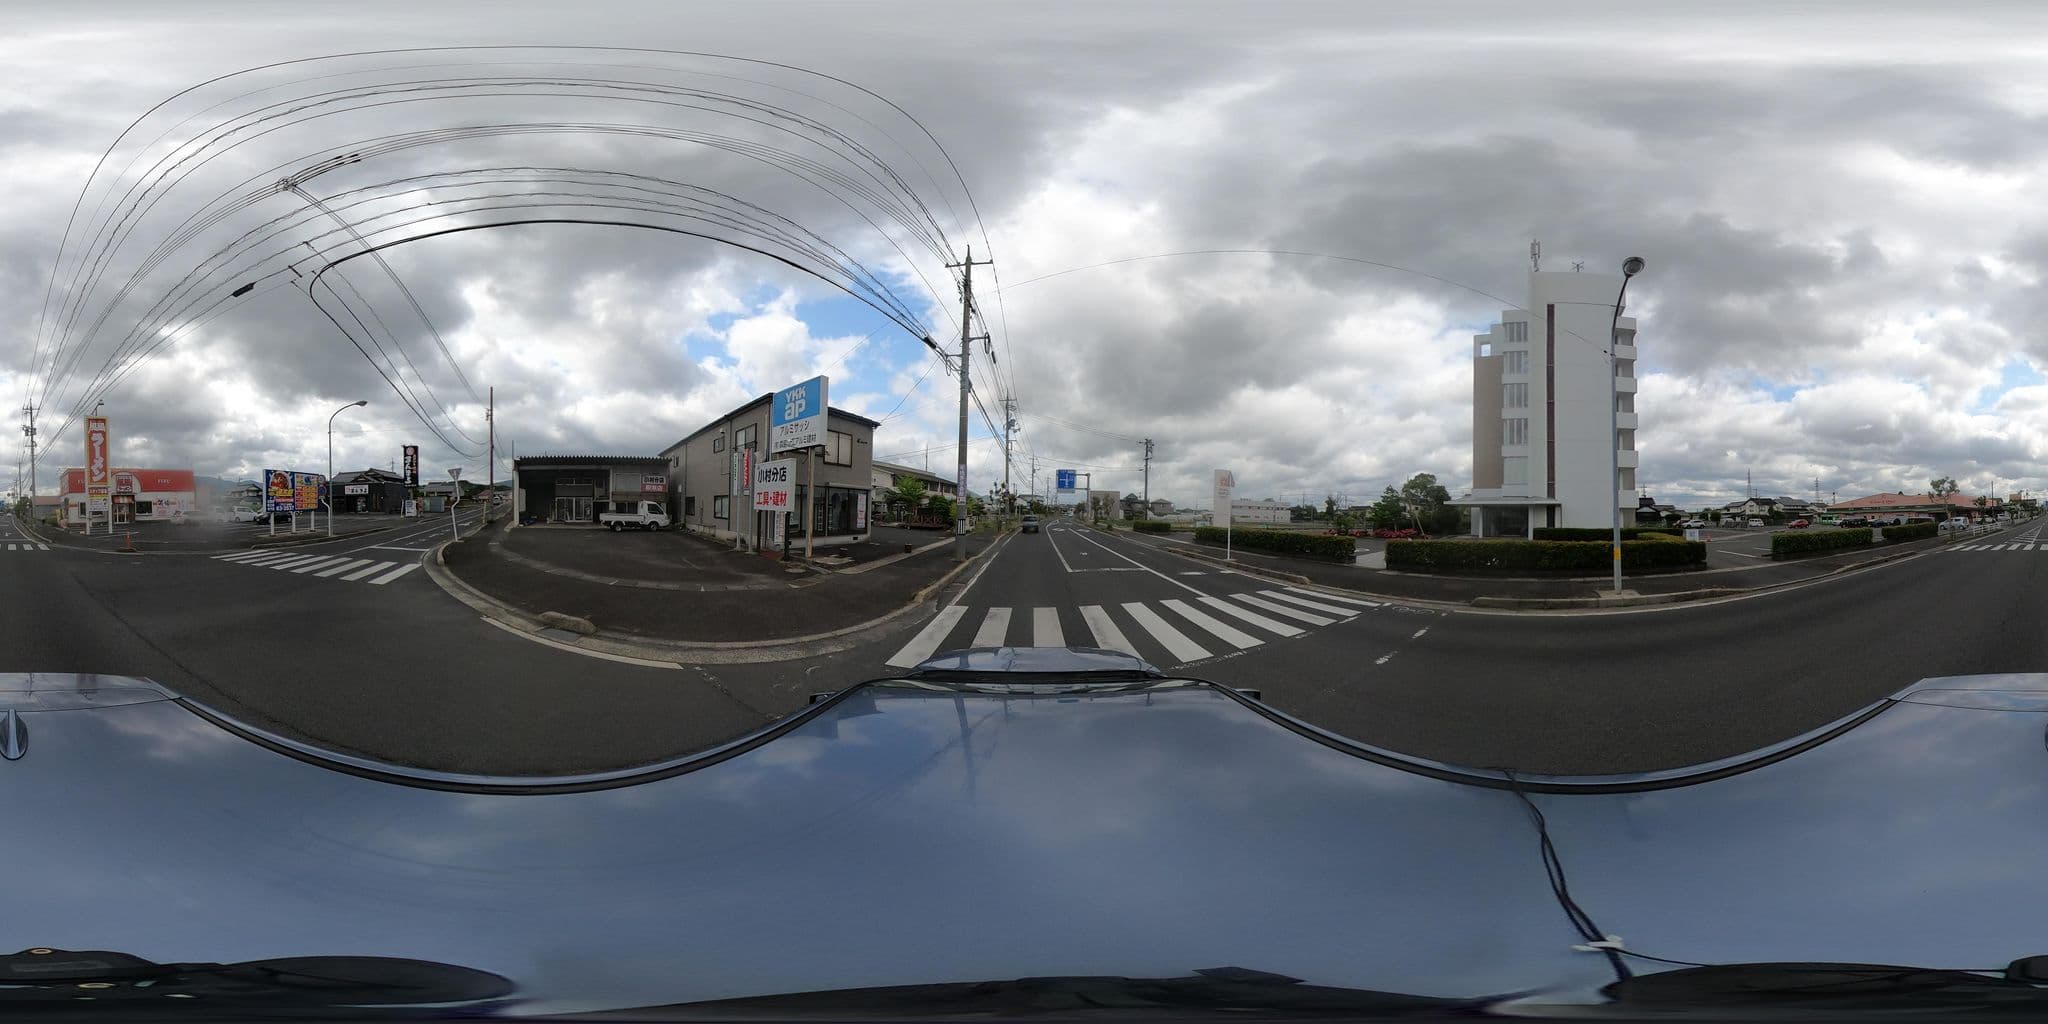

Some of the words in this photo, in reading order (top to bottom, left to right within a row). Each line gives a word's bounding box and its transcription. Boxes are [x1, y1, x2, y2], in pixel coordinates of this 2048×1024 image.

[785, 385, 806, 403] YKK
[784, 399, 806, 420] ap
[779, 420, 810, 437] アルミサッシ
[90, 432, 106, 482] ラーメン
[757, 466, 787, 483] 小村分店
[756, 490, 788, 507] 工具・建材
